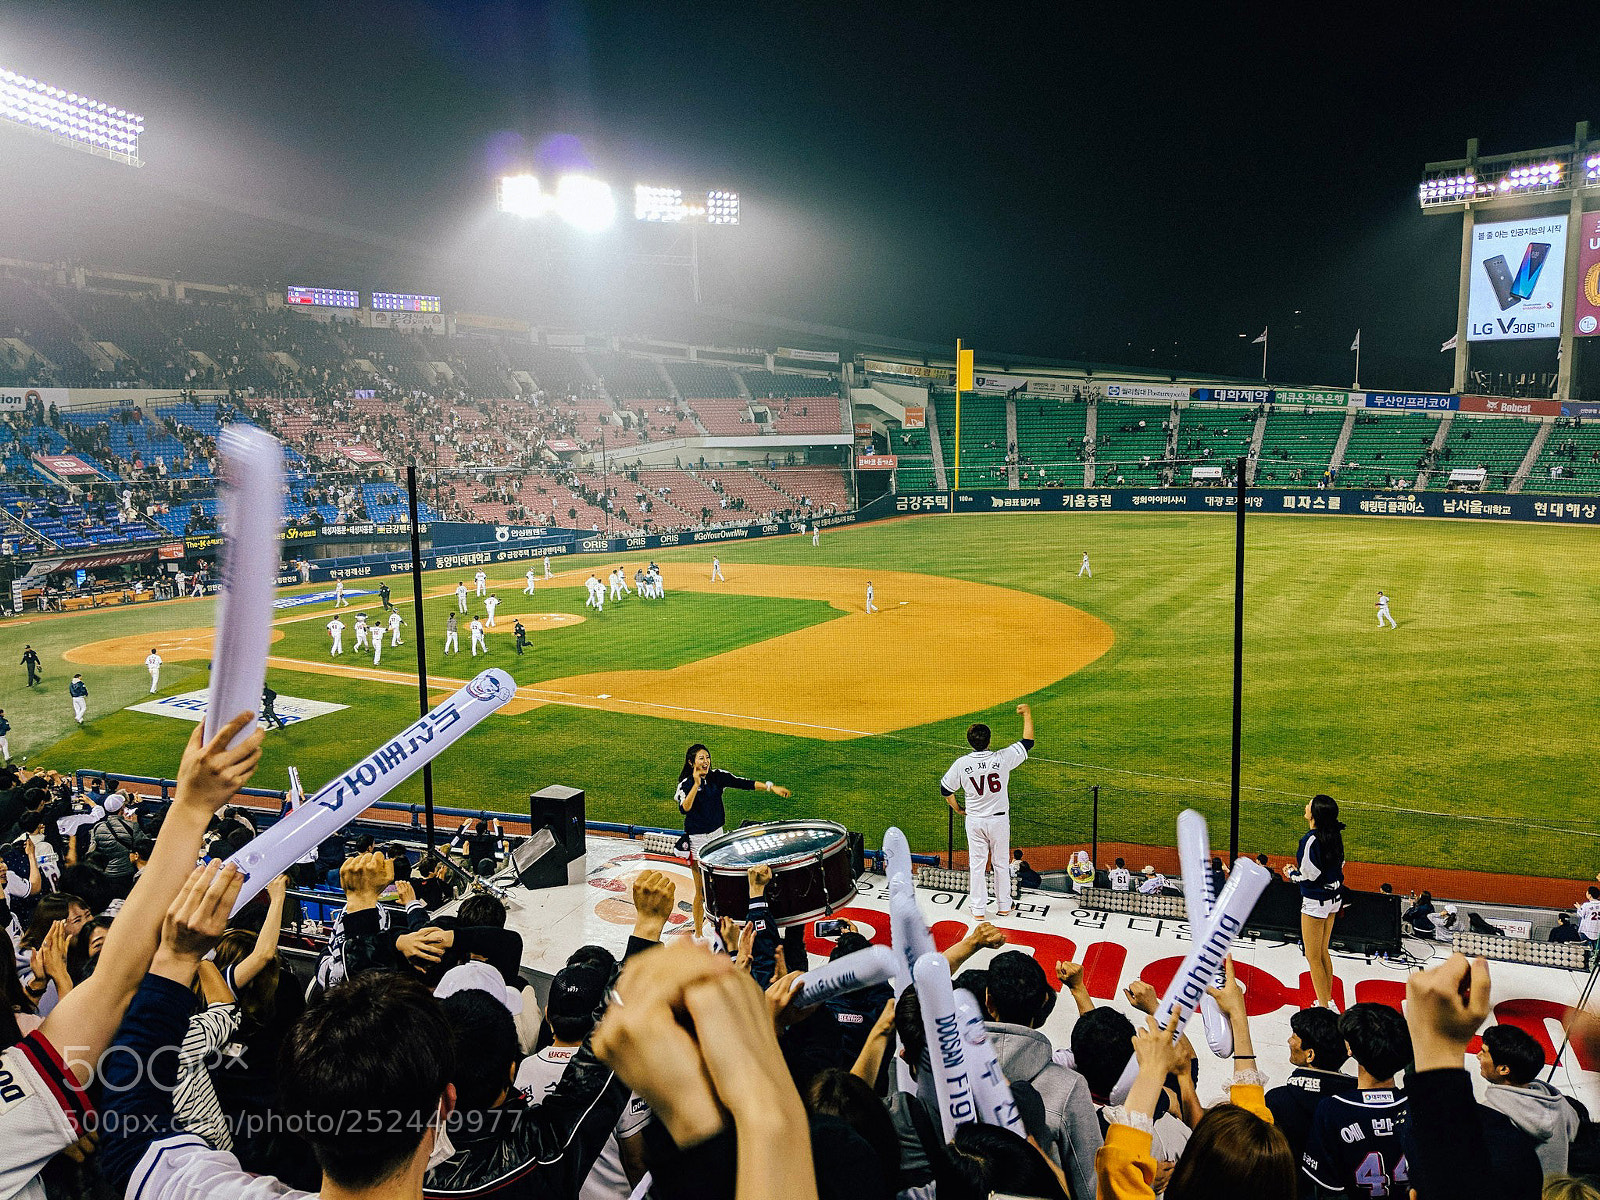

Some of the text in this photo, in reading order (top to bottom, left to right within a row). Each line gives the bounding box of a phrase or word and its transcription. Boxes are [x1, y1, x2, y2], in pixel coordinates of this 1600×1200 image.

[1473, 323, 1493, 335] LG
[0, 394, 22, 404] ion
[1214, 389, 1269, 402] 대화제약
[1276, 391, 1345, 405] 애큐온저축은행
[1374, 395, 1451, 409] 두산인프라코어
[1500, 402, 1531, 413] Bobcat
[896, 495, 948, 511] 금강주택
[1062, 493, 1112, 508] 키움증권
[1534, 501, 1597, 518] 현대해상
[693, 528, 749, 541] #GoYourOwnWay
[762, 524, 779, 532] ORIS
[583, 540, 608, 549] ORIS
[626, 537, 646, 546] ORIS
[660, 534, 679, 543] ORIS
[436, 552, 491, 568] 동양미래대학교
[329, 566, 371, 579] 한국경제신문
[969, 772, 1002, 796] V6
[1117, 876, 1126, 884] 61
[1070, 909, 1109, 930] 앱
[1167, 912, 1241, 1024] Fighting
[935, 1012, 976, 1127] DOOSAN Fig
